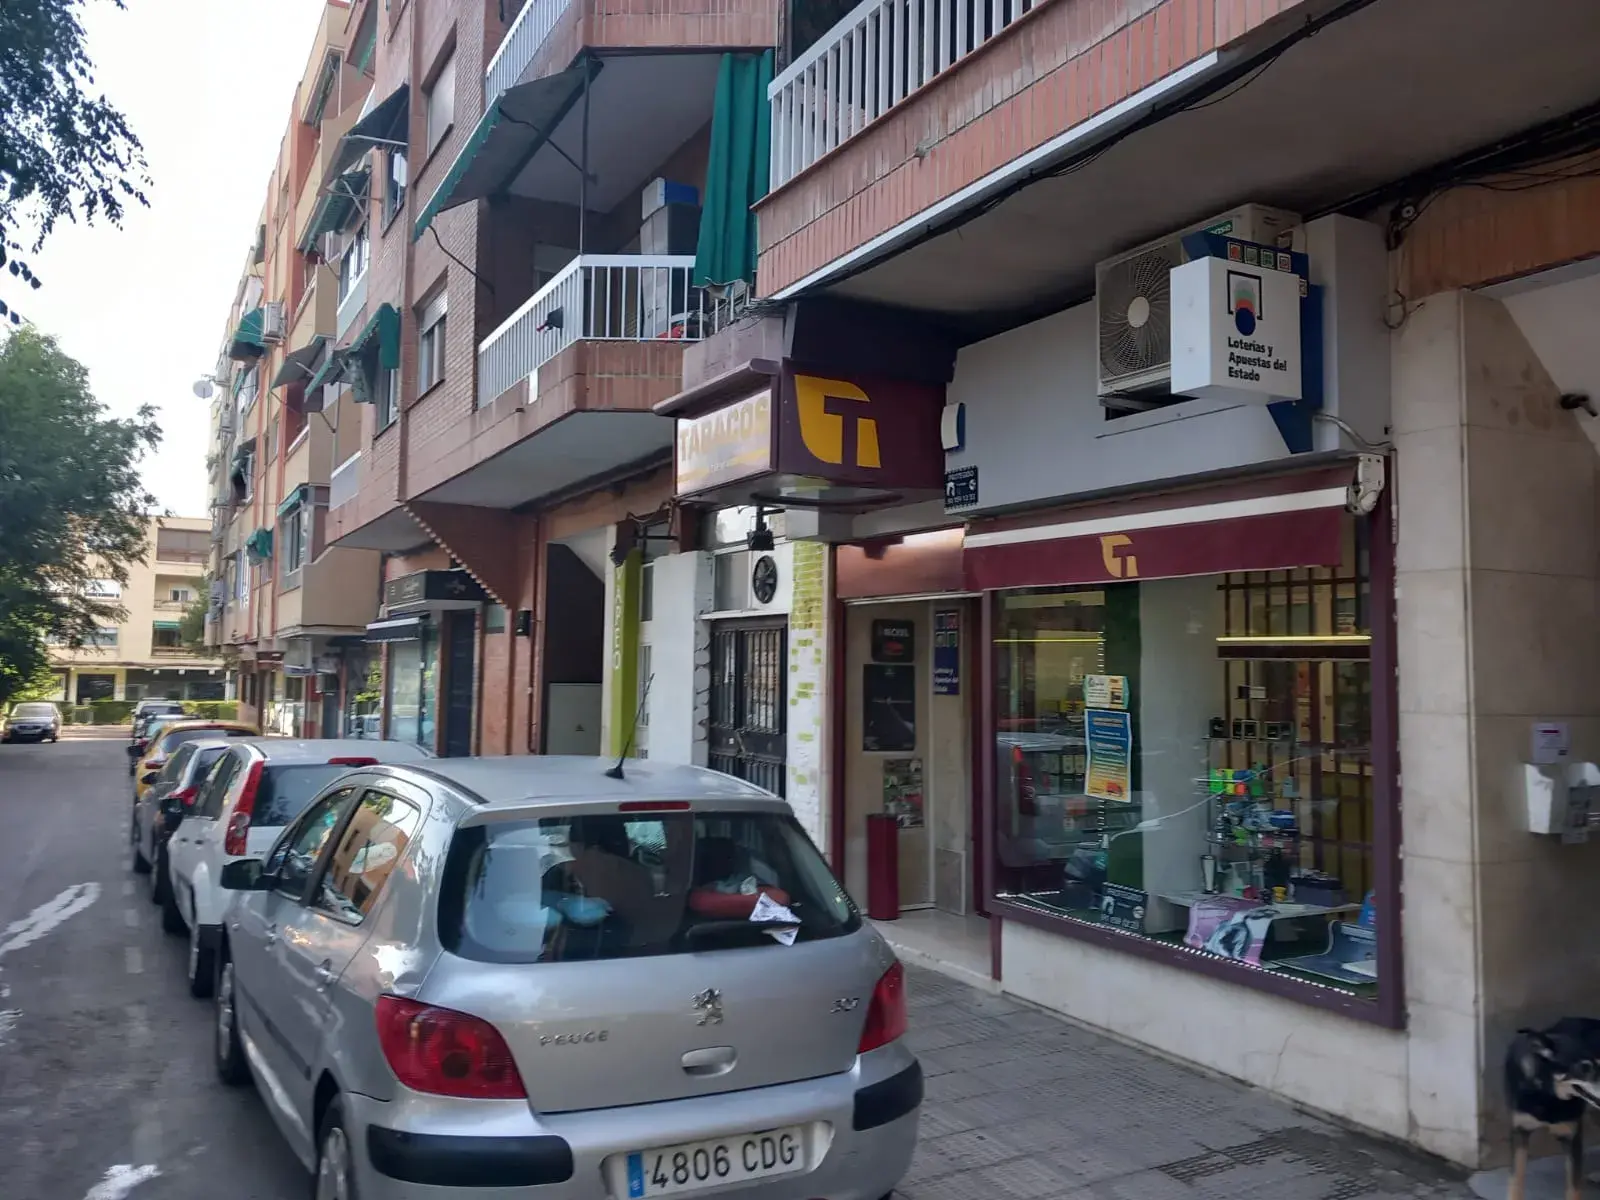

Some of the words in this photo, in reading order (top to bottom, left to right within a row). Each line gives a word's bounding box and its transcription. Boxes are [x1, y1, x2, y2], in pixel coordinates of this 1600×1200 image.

[1228, 351, 1272, 369] Apuestas
[1272, 358, 1288, 372] del
[1267, 346, 1274, 358] y
[1228, 366, 1261, 382] Estado
[678, 396, 771, 462] TABACOS
[651, 1144, 731, 1188] 4806
[742, 1133, 795, 1172] CDG
